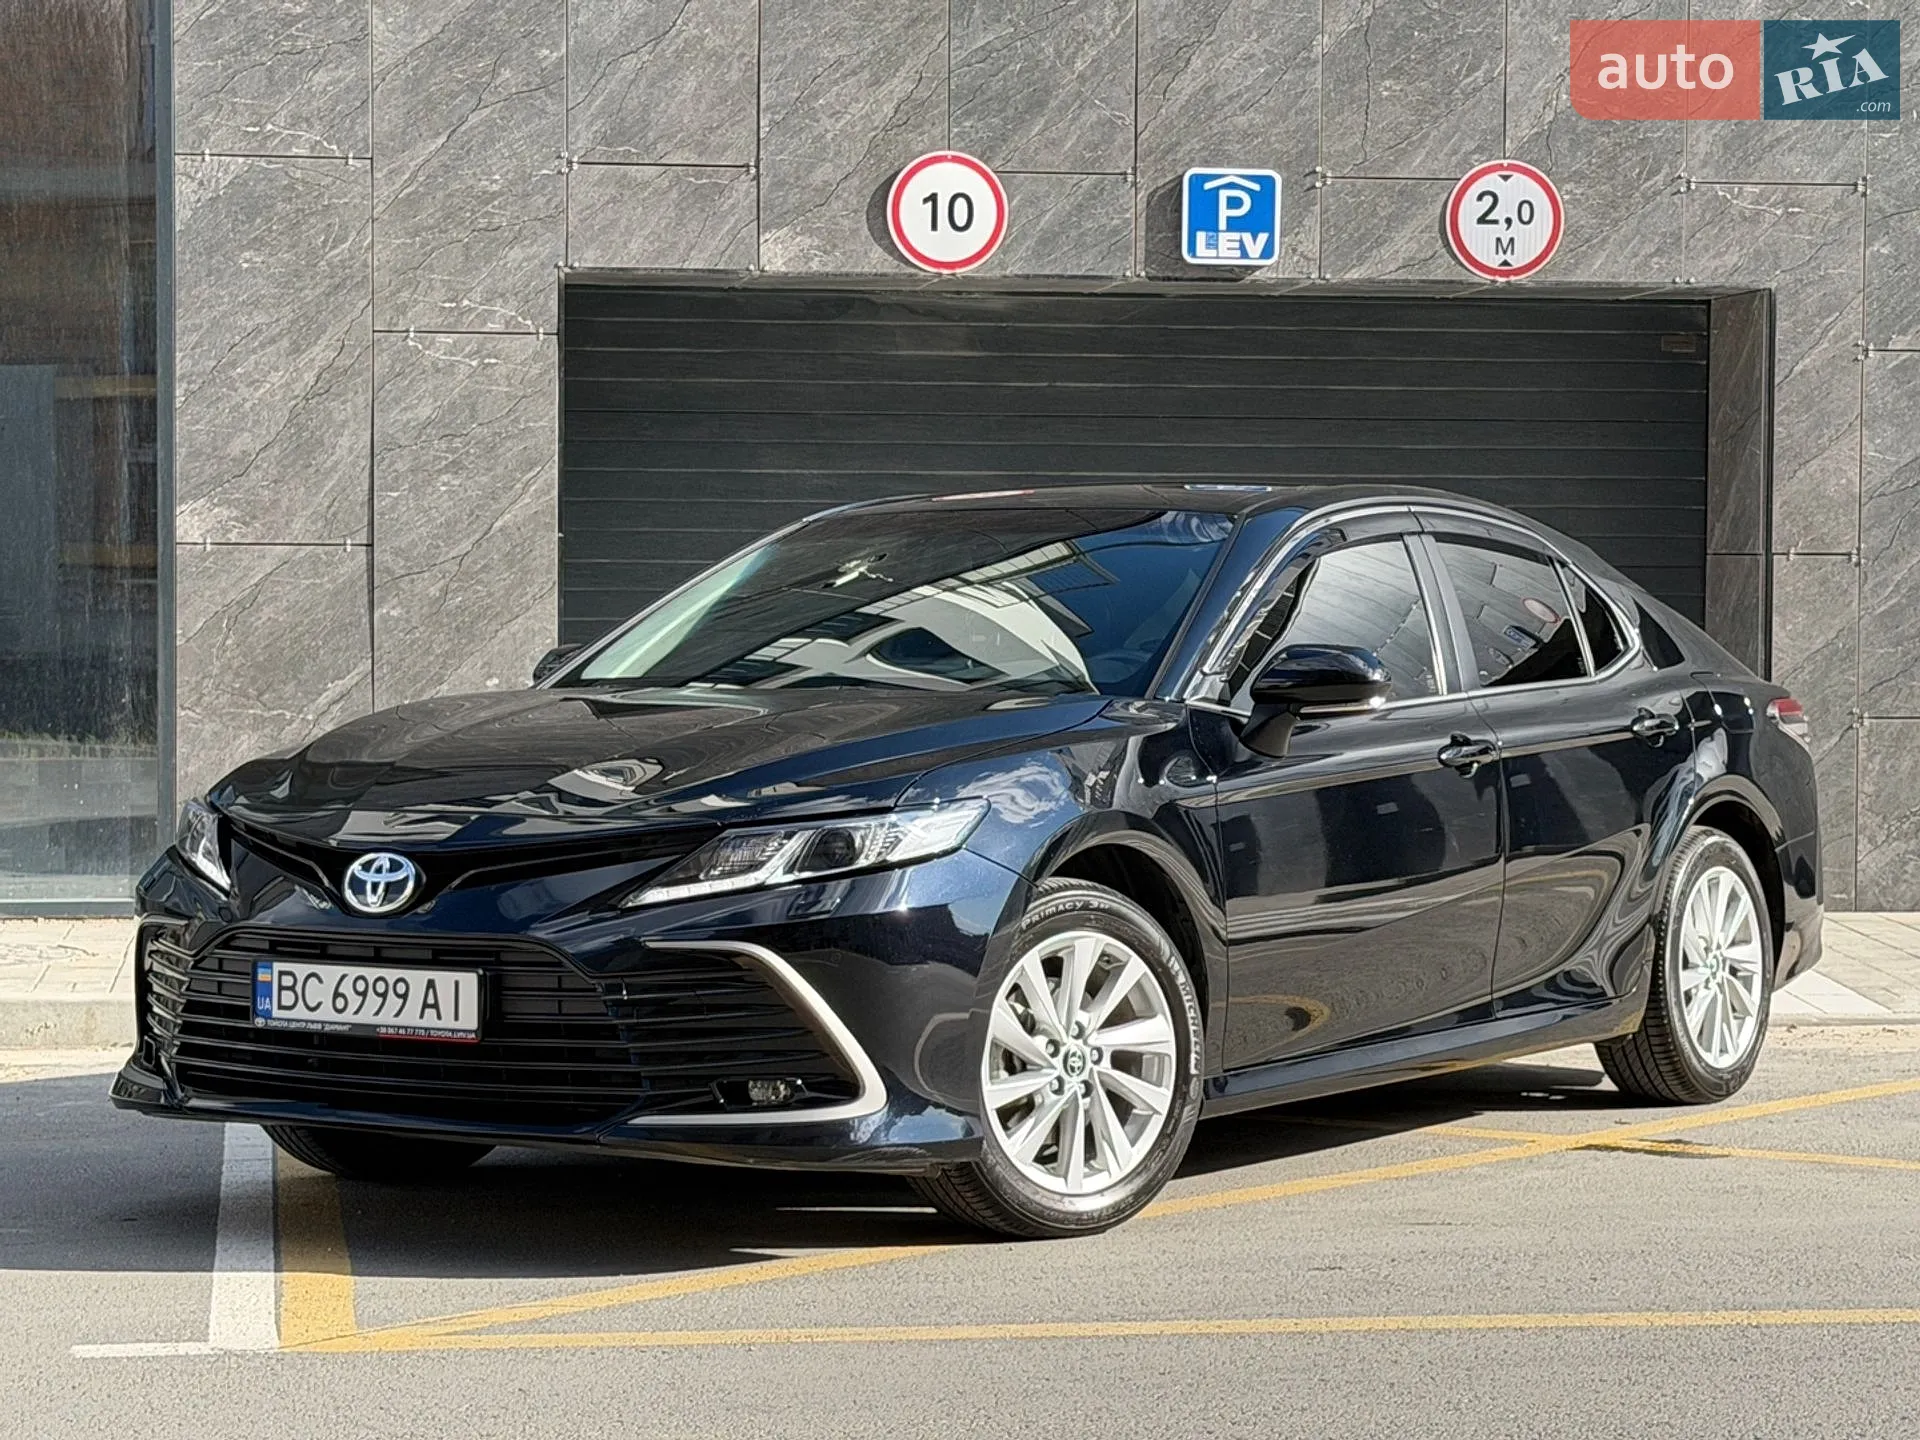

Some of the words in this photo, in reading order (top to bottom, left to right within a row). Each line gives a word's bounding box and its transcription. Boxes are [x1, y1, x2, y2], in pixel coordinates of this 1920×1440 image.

[922, 192, 975, 233] 10
[1218, 189, 1252, 231] P
[1476, 190, 1534, 231] 2,0
[1195, 231, 1270, 258] LEV
[257, 996, 272, 1010] UA
